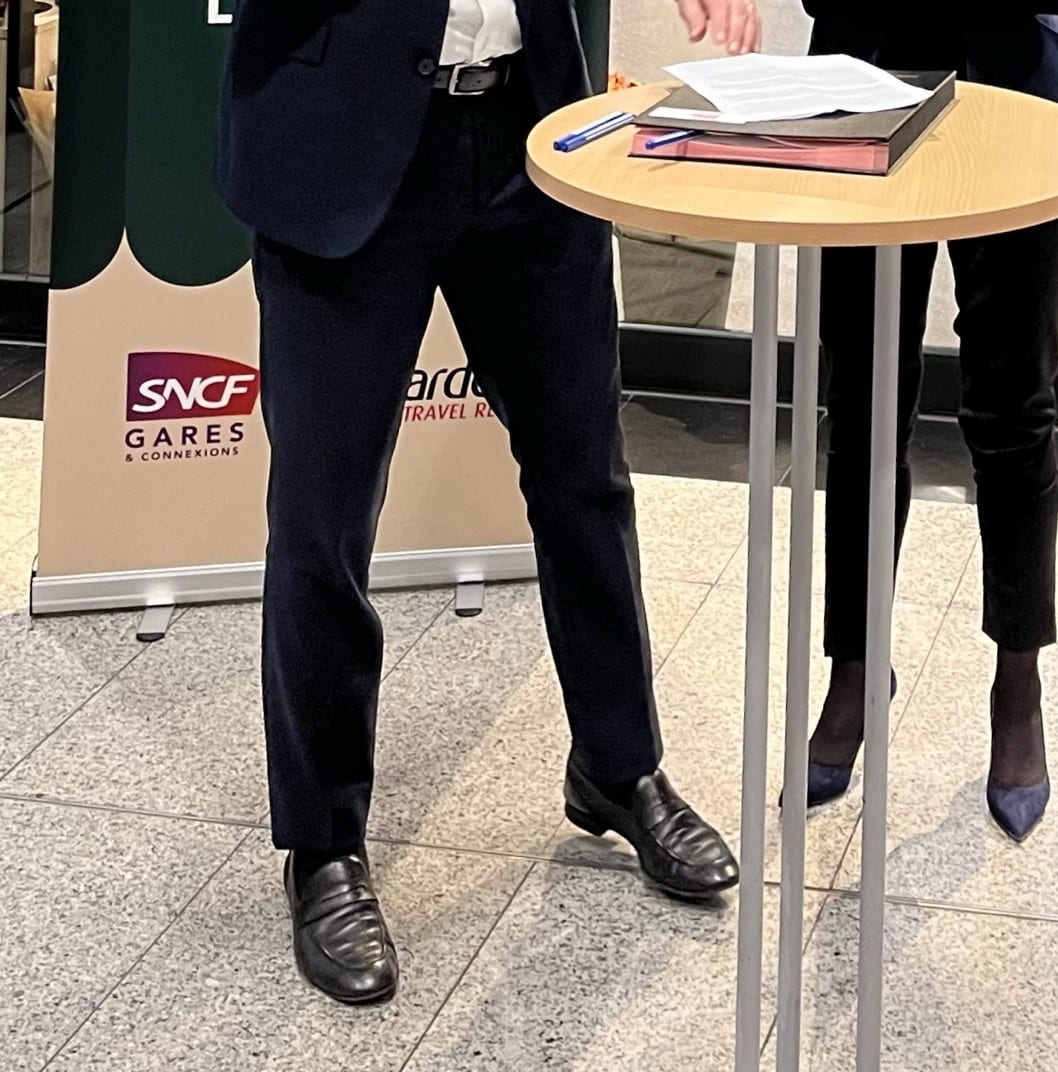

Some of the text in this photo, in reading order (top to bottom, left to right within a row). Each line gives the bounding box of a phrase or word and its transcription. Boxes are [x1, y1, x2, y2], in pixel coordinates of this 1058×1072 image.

[132, 374, 255, 413] SNCF
[404, 402, 466, 423] TRAVEL
[125, 422, 244, 449] GARES
[125, 446, 239, 463] & CONNEXIONS
